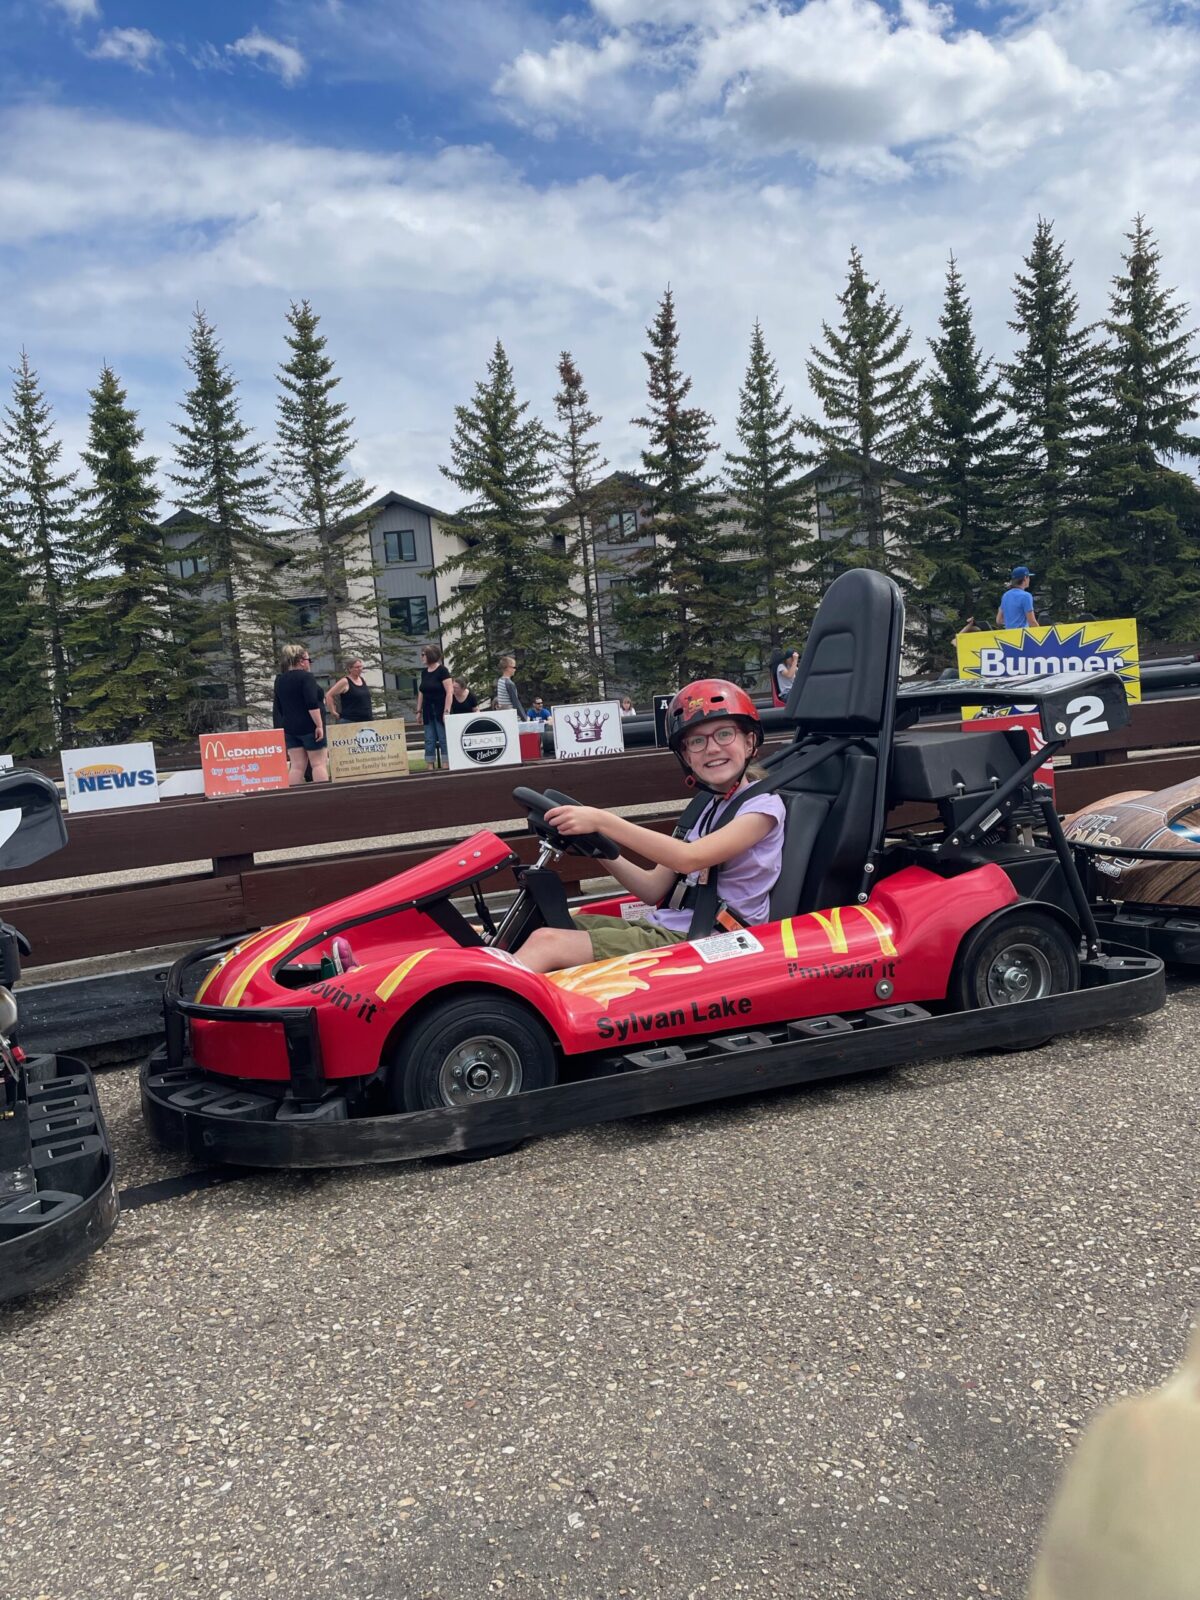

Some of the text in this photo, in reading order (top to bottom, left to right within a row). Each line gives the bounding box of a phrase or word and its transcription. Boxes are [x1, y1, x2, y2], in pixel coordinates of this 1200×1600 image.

[980, 648, 1124, 677] Bumper
[1066, 695, 1110, 737] 2
[205, 740, 283, 760] McDonald's
[332, 733, 402, 747] ROUNDABOUT
[348, 743, 388, 755] EATERY
[77, 769, 155, 793] NEWS
[787, 962, 821, 978] i'm
[881, 961, 896, 978] it
[357, 998, 377, 1024] it
[597, 996, 752, 1041] Sylvan Lake
